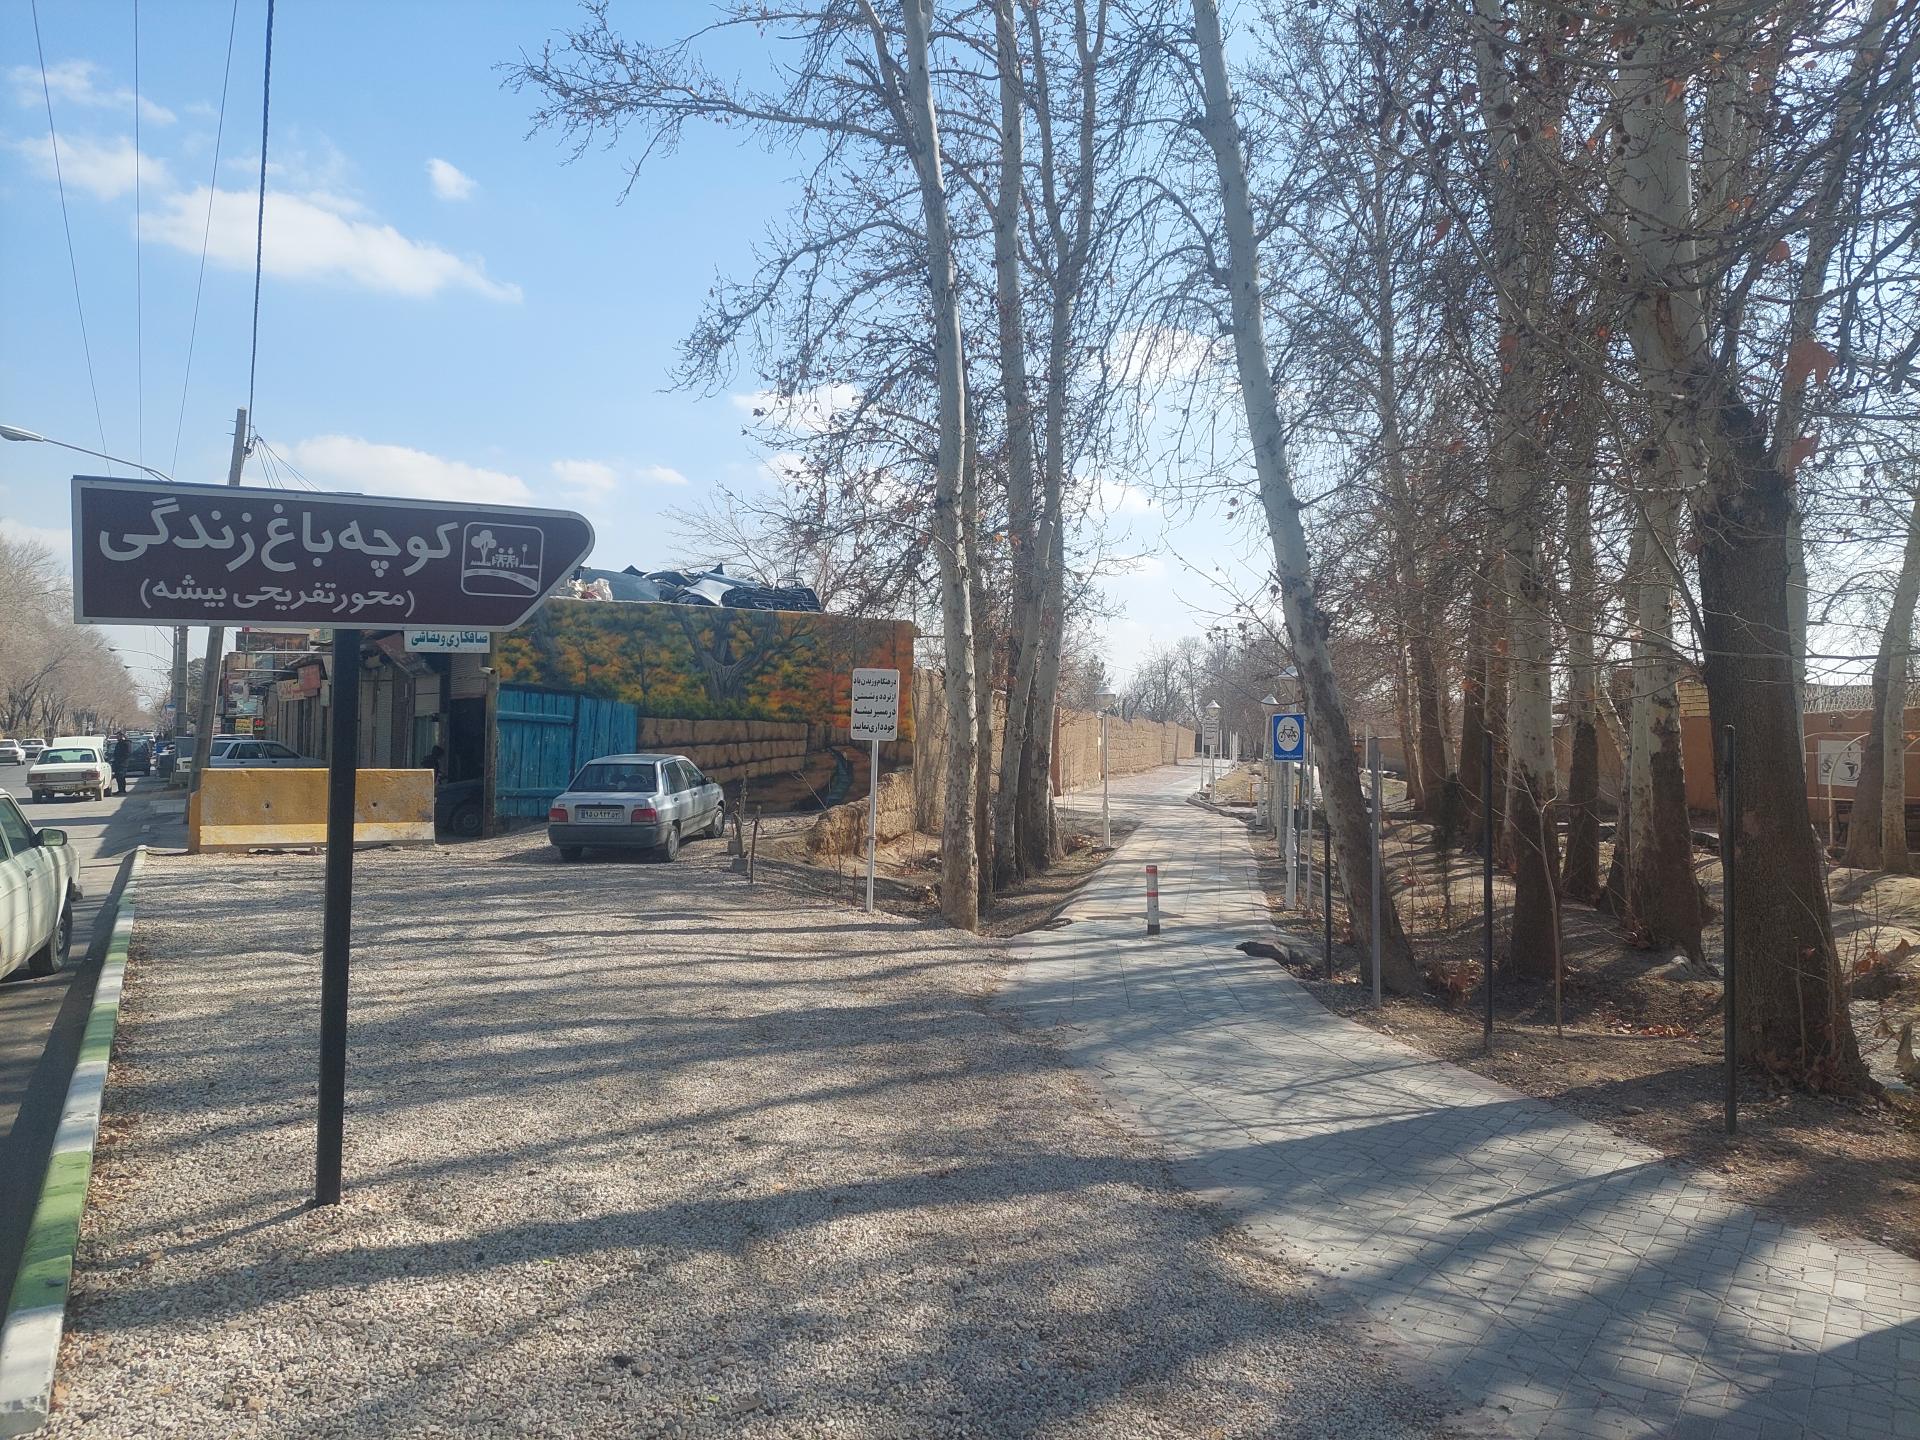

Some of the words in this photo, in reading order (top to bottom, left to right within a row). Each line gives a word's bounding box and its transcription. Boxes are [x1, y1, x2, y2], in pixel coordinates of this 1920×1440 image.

[99, 496, 256, 573] زندگی
[260, 503, 334, 573] باغ
[338, 519, 459, 578] کوچه
[139, 574, 227, 609] بیشه)
[232, 582, 337, 611] تفریحی
[332, 589, 415, 618] (محور
[446, 632, 489, 648] صافکاری
[876, 678, 890, 686] هنگام
[890, 678, 896, 686] در
[874, 708, 888, 718] مسیر
[888, 708, 896, 718] در
